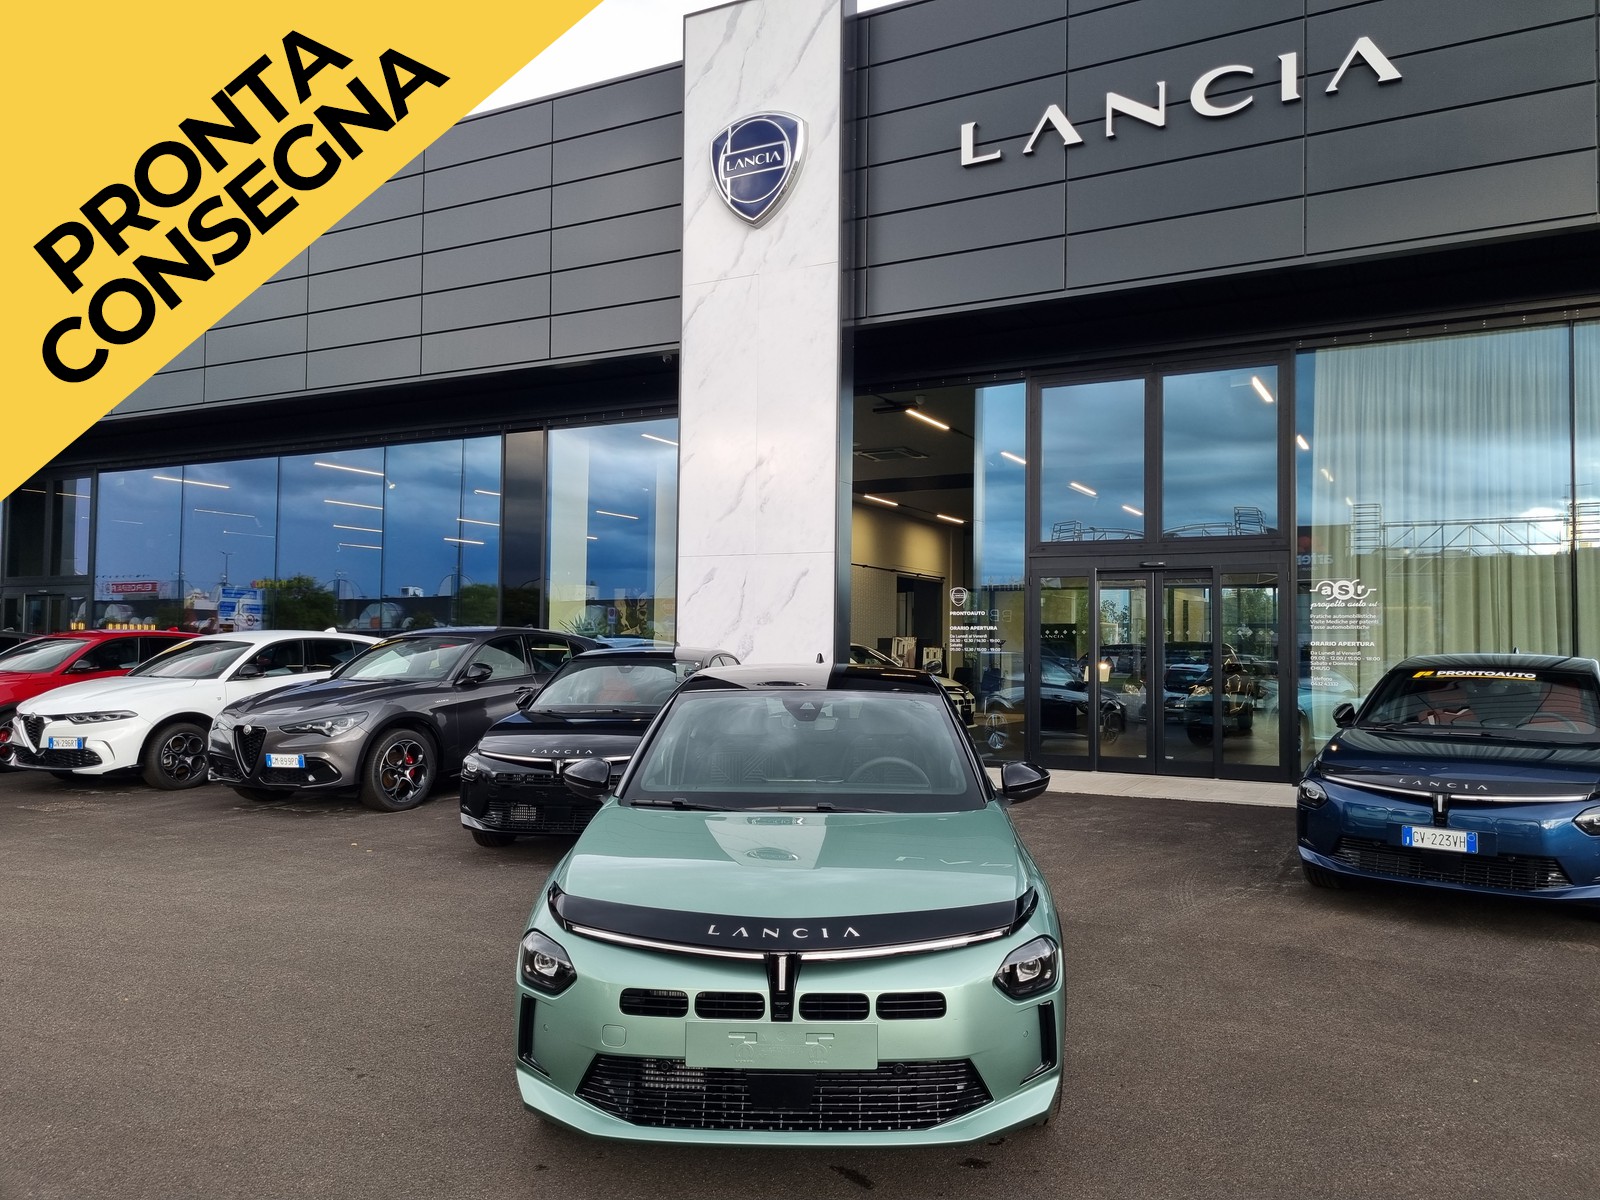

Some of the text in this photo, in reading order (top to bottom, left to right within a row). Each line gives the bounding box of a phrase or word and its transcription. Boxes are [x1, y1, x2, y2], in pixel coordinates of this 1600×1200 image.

[960, 36, 1402, 167] LANCIA
[726, 150, 781, 171] LANCIA
[1310, 600, 1345, 610] progetto
[1399, 778, 1488, 790] LANCIA
[707, 924, 861, 939] LANCIA
